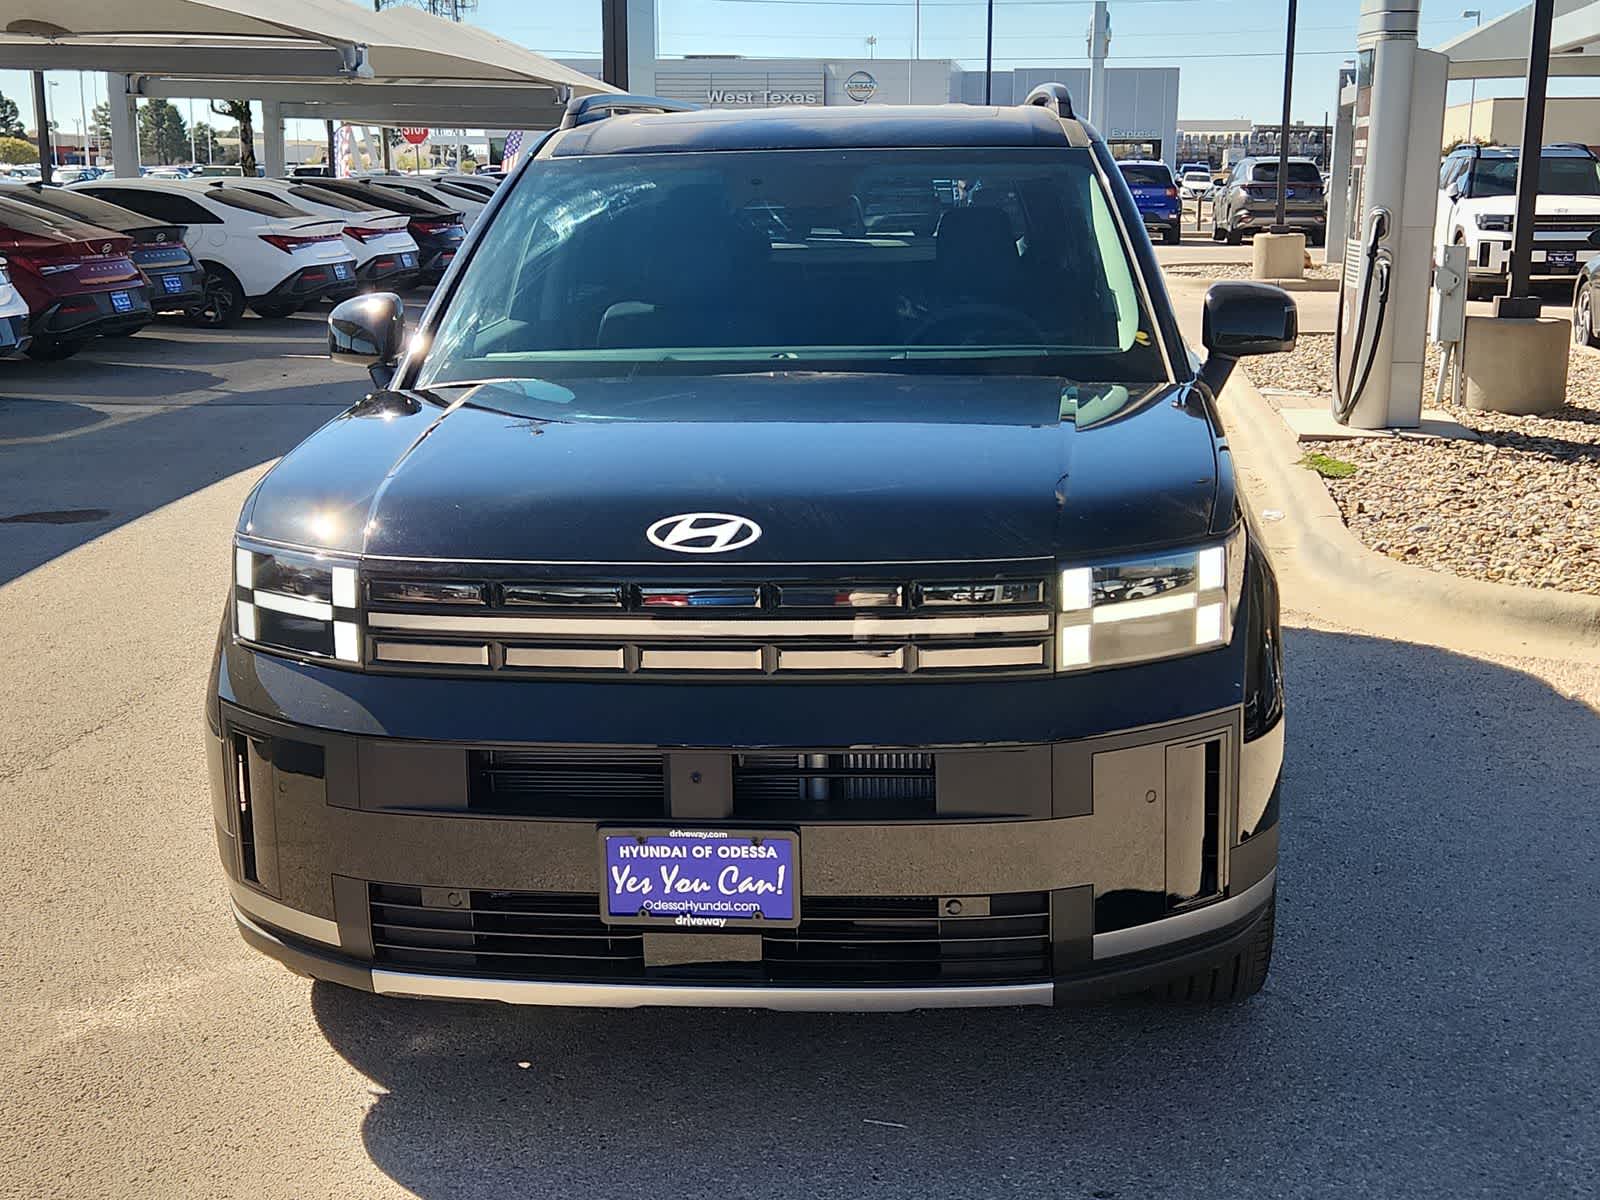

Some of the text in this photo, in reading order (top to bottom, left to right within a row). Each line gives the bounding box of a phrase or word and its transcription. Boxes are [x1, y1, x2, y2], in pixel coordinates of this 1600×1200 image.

[707, 90, 817, 104] West Texas
[669, 829, 728, 840] driveway.com
[619, 846, 778, 859] HYUNDAI OF ODESSA
[611, 864, 786, 895] Yes You Can!
[643, 900, 760, 912] OdessaHyundai.com
[675, 914, 727, 928] driveway
